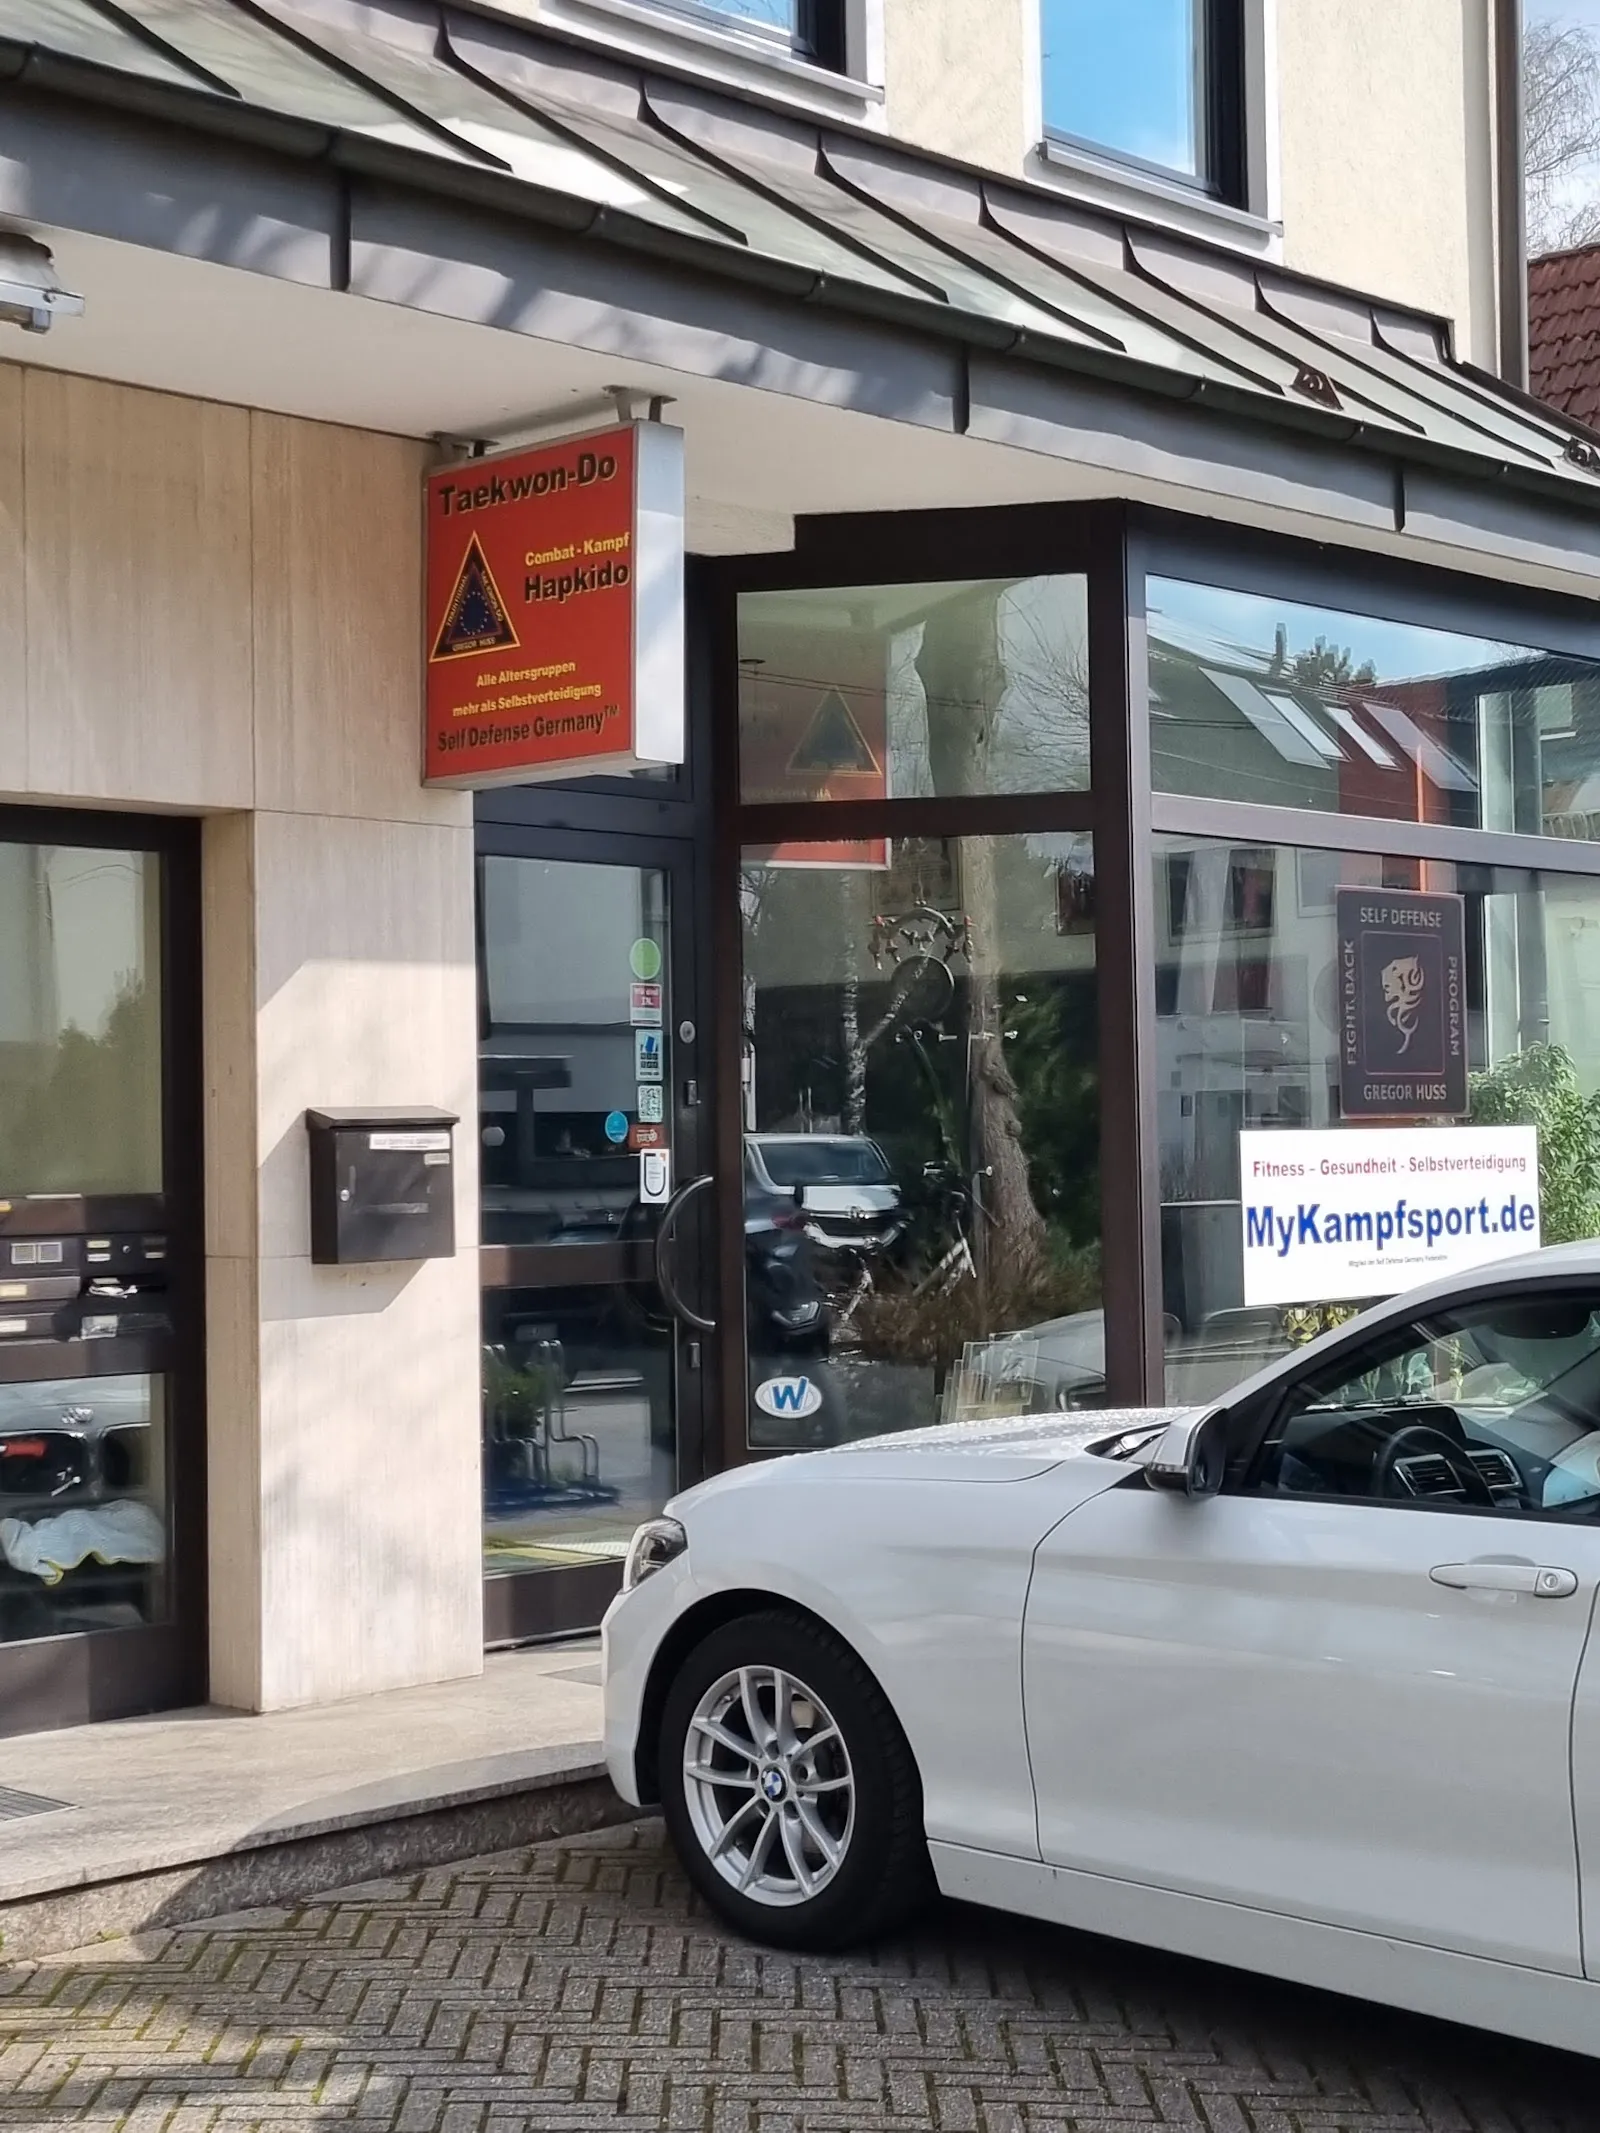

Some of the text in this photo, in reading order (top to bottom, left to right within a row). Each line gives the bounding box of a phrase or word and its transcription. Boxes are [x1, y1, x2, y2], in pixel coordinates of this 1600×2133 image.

[438, 453, 618, 517] Taekwon-Do
[525, 544, 575, 567] Combat
[583, 531, 631, 555] Kampf
[525, 560, 631, 604] Hapkido
[476, 661, 576, 687] Alle Altersgruppen
[452, 684, 602, 717] mehr als Selbstverteidigung
[437, 727, 466, 751] Self
[469, 722, 531, 747] Defense
[1360, 907, 1443, 928] SELF DEFENSE
[1343, 940, 1356, 996] BACK
[1448, 955, 1460, 1057] PROGRAM
[1363, 1083, 1447, 1101] GREGOR HUSS
[1253, 1160, 1305, 1178] Fitness
[1320, 1157, 1397, 1176] Gesundheit
[1408, 1154, 1527, 1173] Selbstverteidigung
[1246, 1194, 1535, 1257] MyKampfsport.de
